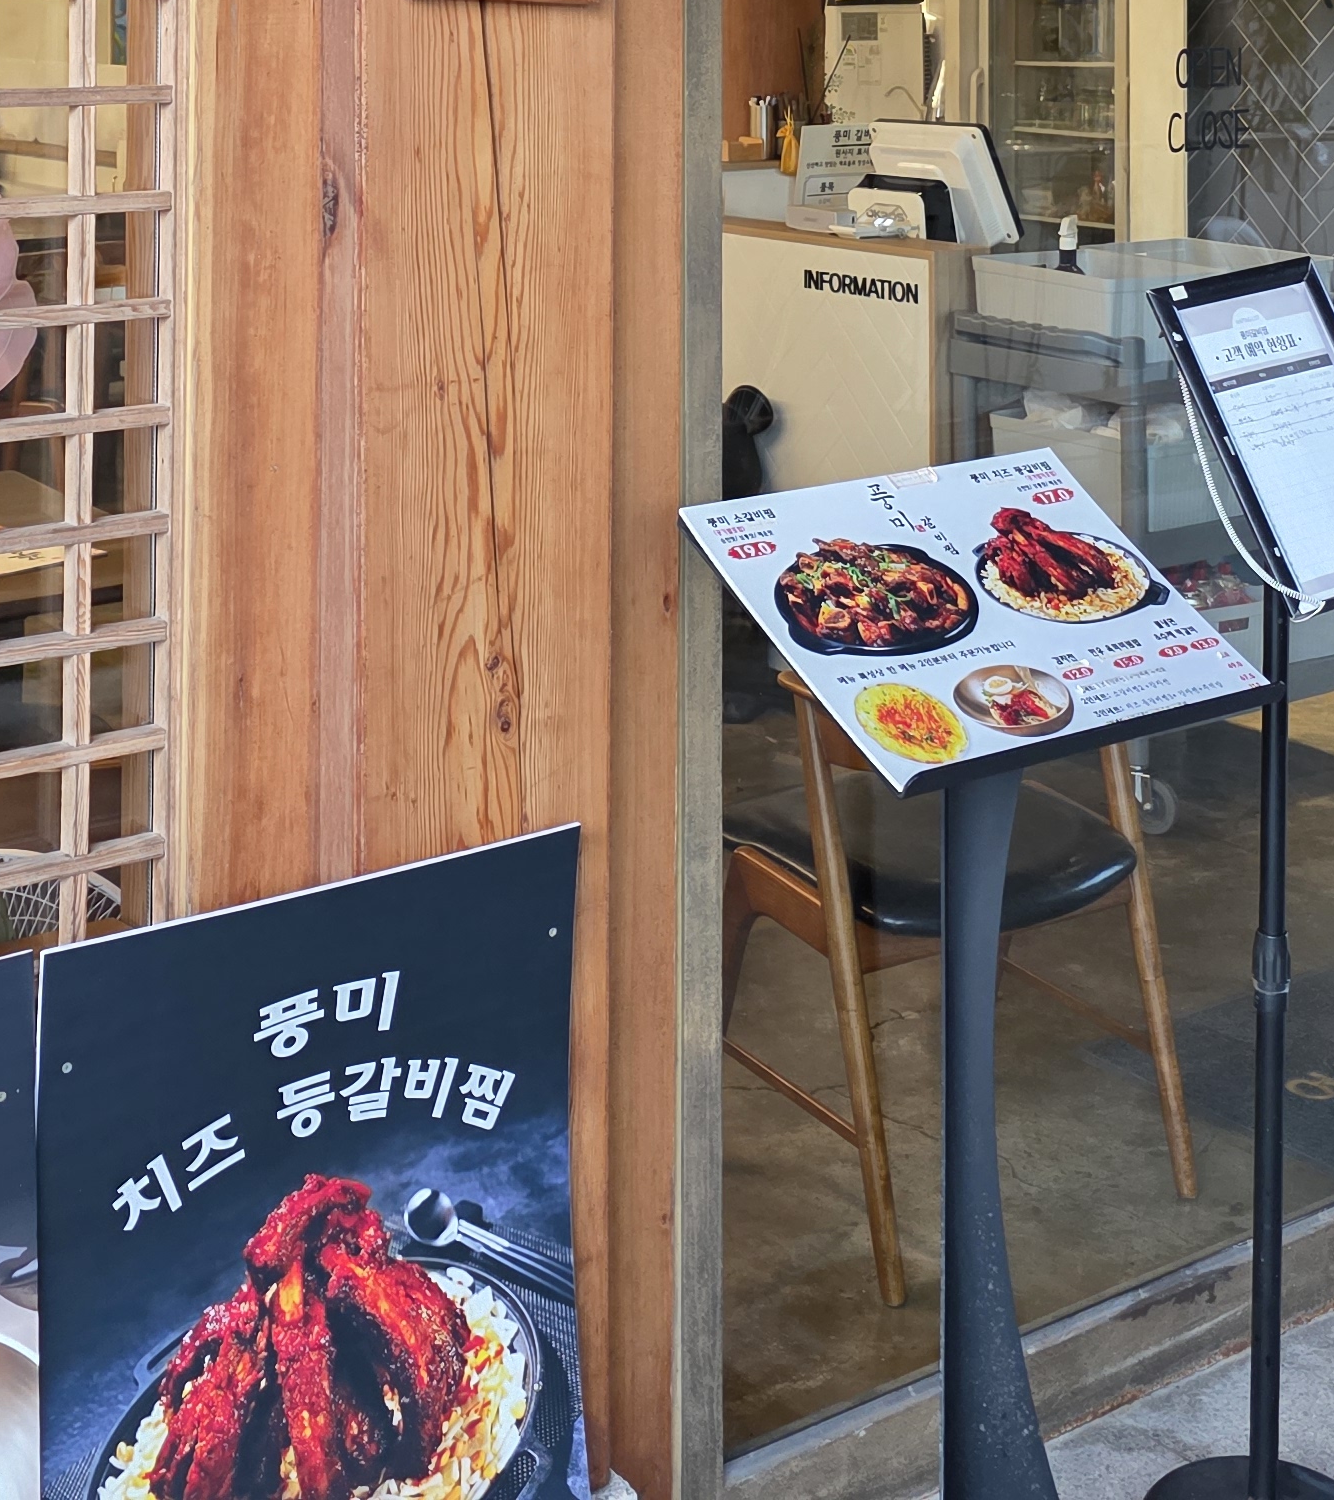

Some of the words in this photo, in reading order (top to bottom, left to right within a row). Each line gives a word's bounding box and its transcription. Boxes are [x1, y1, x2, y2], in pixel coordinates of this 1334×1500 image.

[1176, 47, 1242, 88] OPEN
[833, 129, 851, 143] 풍미
[1168, 108, 1250, 153] CLOSE
[804, 269, 918, 304] INFORMATION
[1221, 344, 1245, 363] 고객
[1244, 340, 1267, 357] 예약
[992, 468, 1013, 479] 치즈
[1037, 489, 1070, 504] 17.0
[867, 484, 915, 532] 풍미
[706, 516, 730, 528] 풍미
[734, 508, 776, 524] 소갈비찜
[734, 542, 771, 559] 19.0
[1164, 646, 1183, 657] 9.0
[1193, 638, 1217, 650] 13.0
[1117, 656, 1142, 668] 15.0
[1066, 668, 1092, 680] 12.0
[253, 971, 401, 1058] 풍미
[112, 1114, 246, 1231] 치즈
[277, 1057, 516, 1138] 등갈비찜
